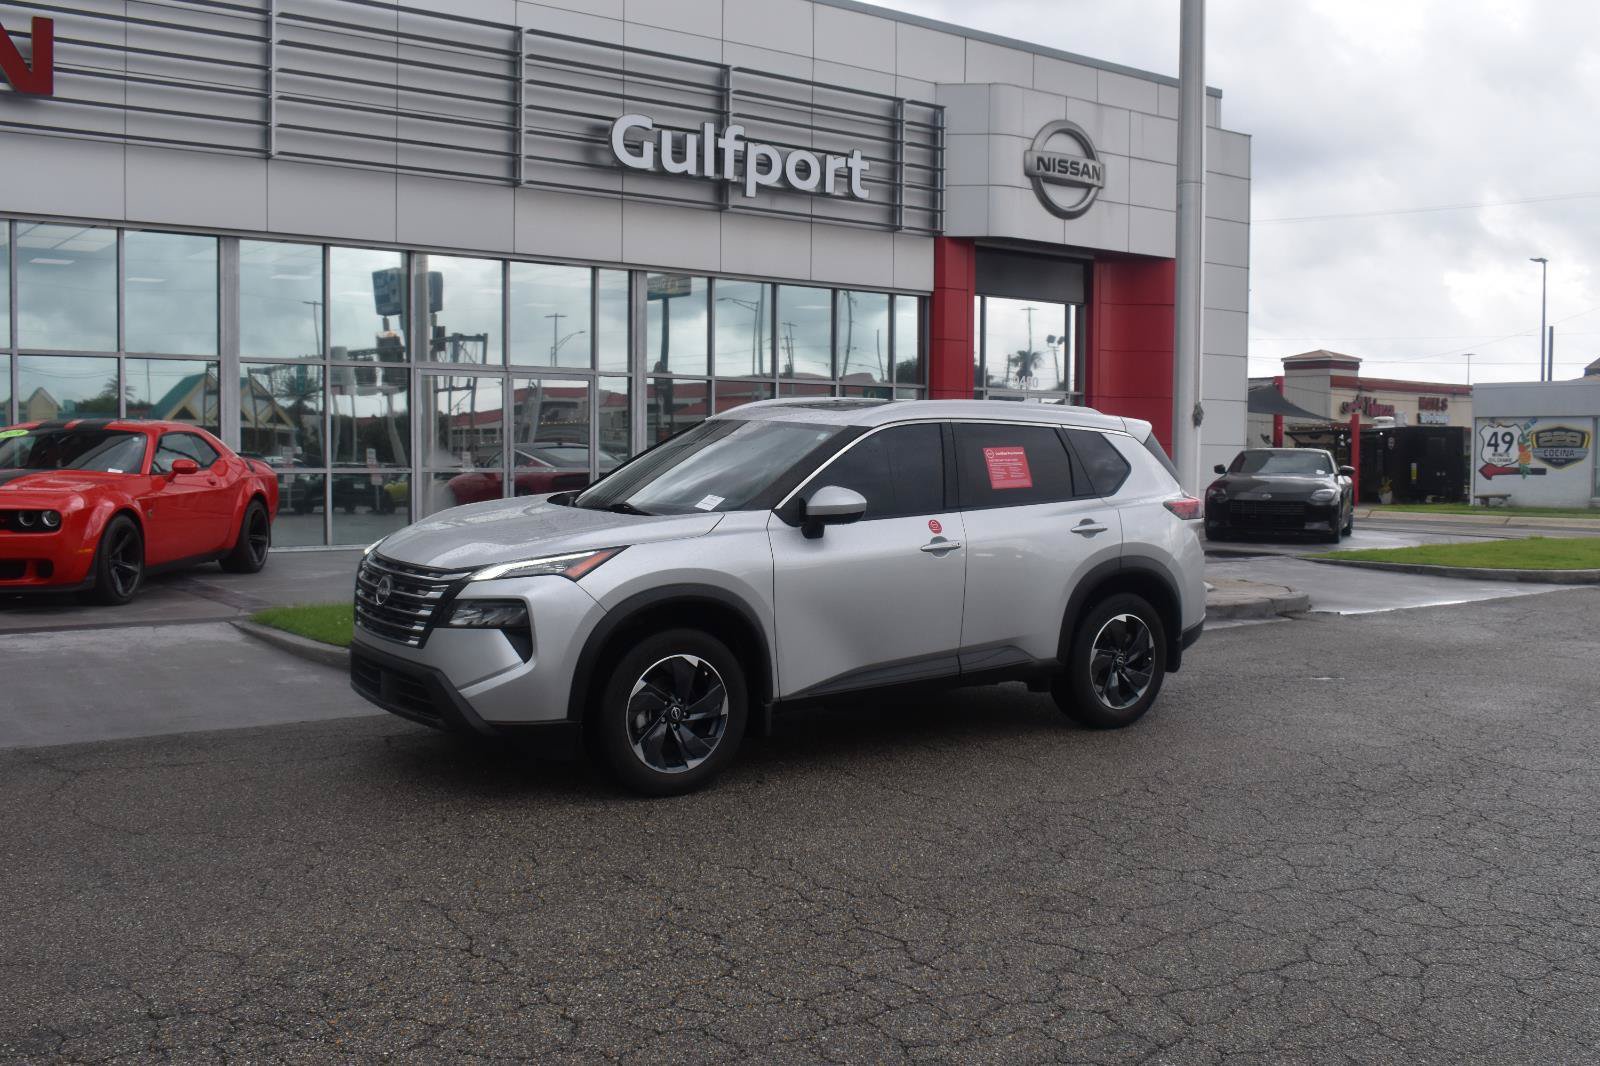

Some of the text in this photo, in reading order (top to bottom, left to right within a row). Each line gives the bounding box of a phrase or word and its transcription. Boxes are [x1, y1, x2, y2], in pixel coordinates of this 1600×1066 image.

[610, 114, 871, 199] Gulfport
[1036, 156, 1101, 181] NISSAN
[1486, 431, 1515, 453] 49
